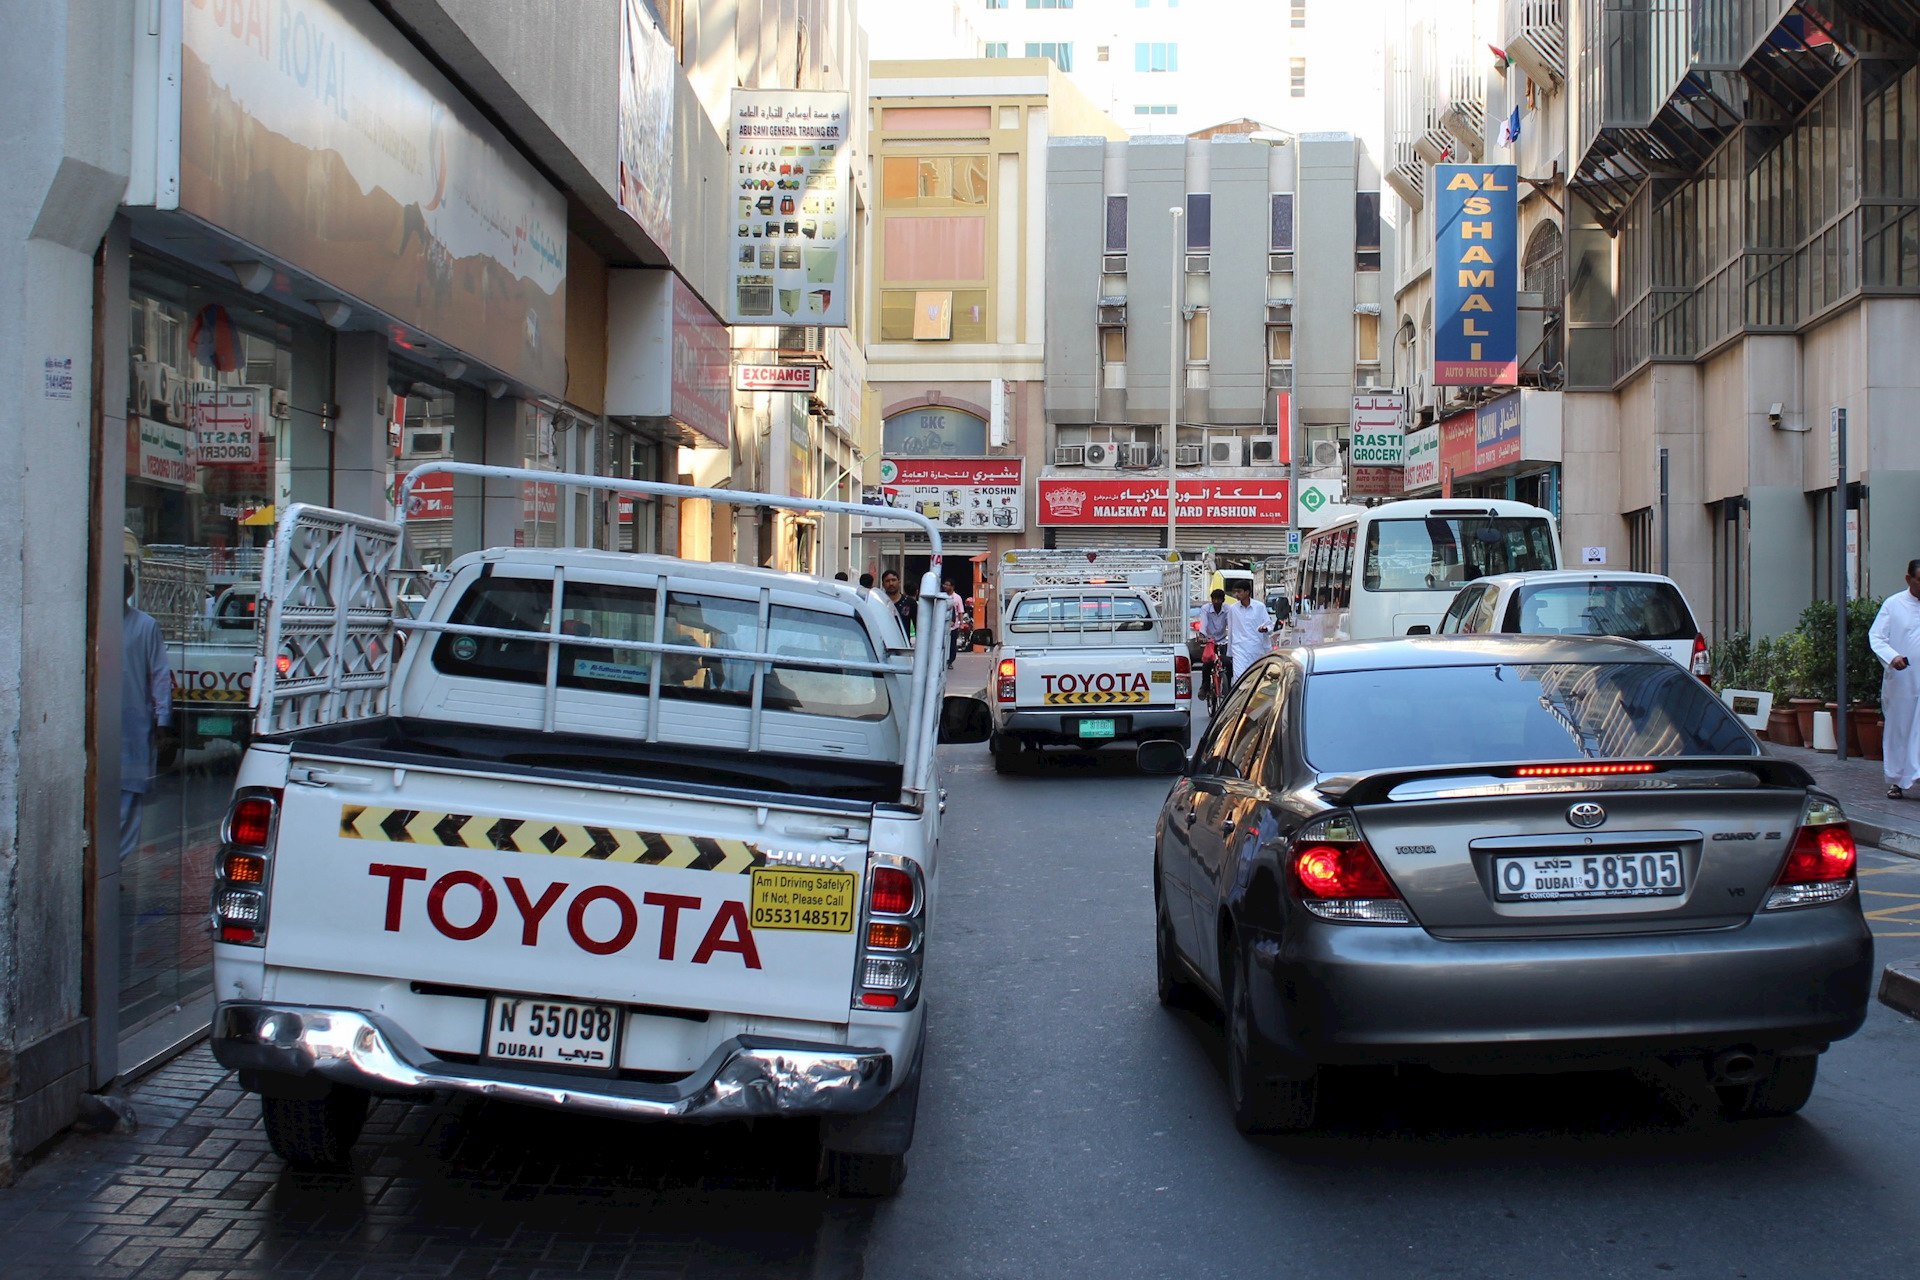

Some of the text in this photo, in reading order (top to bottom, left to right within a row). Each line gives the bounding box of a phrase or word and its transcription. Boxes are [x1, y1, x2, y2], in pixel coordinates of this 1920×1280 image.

[739, 125, 753, 136] ABU
[753, 125, 769, 137] SAMI
[769, 125, 798, 137] GENERAL
[798, 126, 826, 138] TRADING
[1446, 173, 1509, 191] AL
[1458, 197, 1495, 361] SHAMALI
[743, 368, 811, 382] EXCHANGE
[1445, 368, 1464, 378] AUTO
[1466, 368, 1488, 378] PARTS
[920, 416, 945, 429] BKC
[1354, 434, 1402, 446] RASTI
[1354, 448, 1402, 461] GROCERY
[982, 487, 1017, 495] KOSHIN
[1093, 506, 1148, 517] MALEKAT
[1151, 506, 1166, 517] AL
[1206, 506, 1257, 517] FASHION
[1290, 533, 1297, 541] P
[1041, 673, 1150, 693] TOYOTA
[1712, 832, 1761, 841] CAMRY
[1395, 844, 1437, 855] TOYOTA
[1583, 854, 1677, 889] 58505
[756, 876, 772, 887] Am
[780, 876, 814, 892] Driving
[816, 878, 851, 893] Safely?
[1535, 876, 1574, 890] DUBAI
[762, 892, 844, 906] If Not, Please Call
[369, 863, 762, 970] TOYOTA
[755, 908, 849, 926] 0553148517
[500, 1003, 612, 1042] N 55098
[497, 1042, 543, 1058] DUBAI
